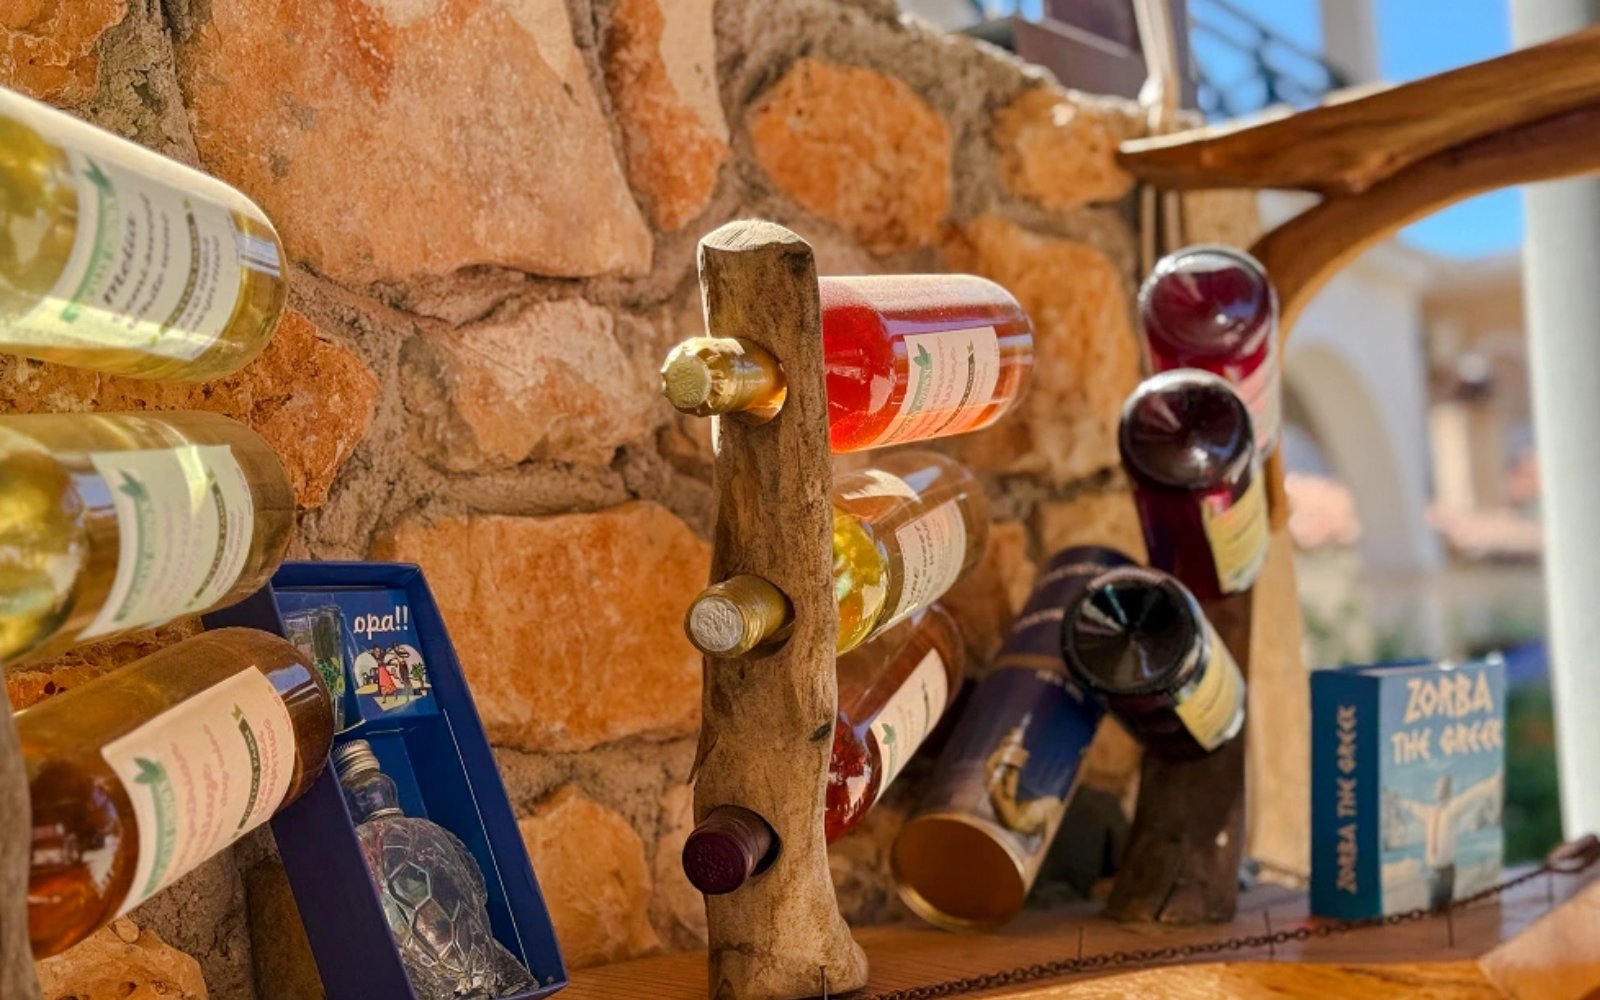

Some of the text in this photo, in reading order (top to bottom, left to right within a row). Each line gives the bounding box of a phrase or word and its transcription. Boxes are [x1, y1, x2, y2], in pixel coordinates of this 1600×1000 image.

[353, 605, 408, 640] opa!!
[1405, 671, 1493, 724] ZORBA
[1392, 718, 1503, 763] THE GREEK
[1337, 705, 1357, 893] ZORBA THE GREEK
